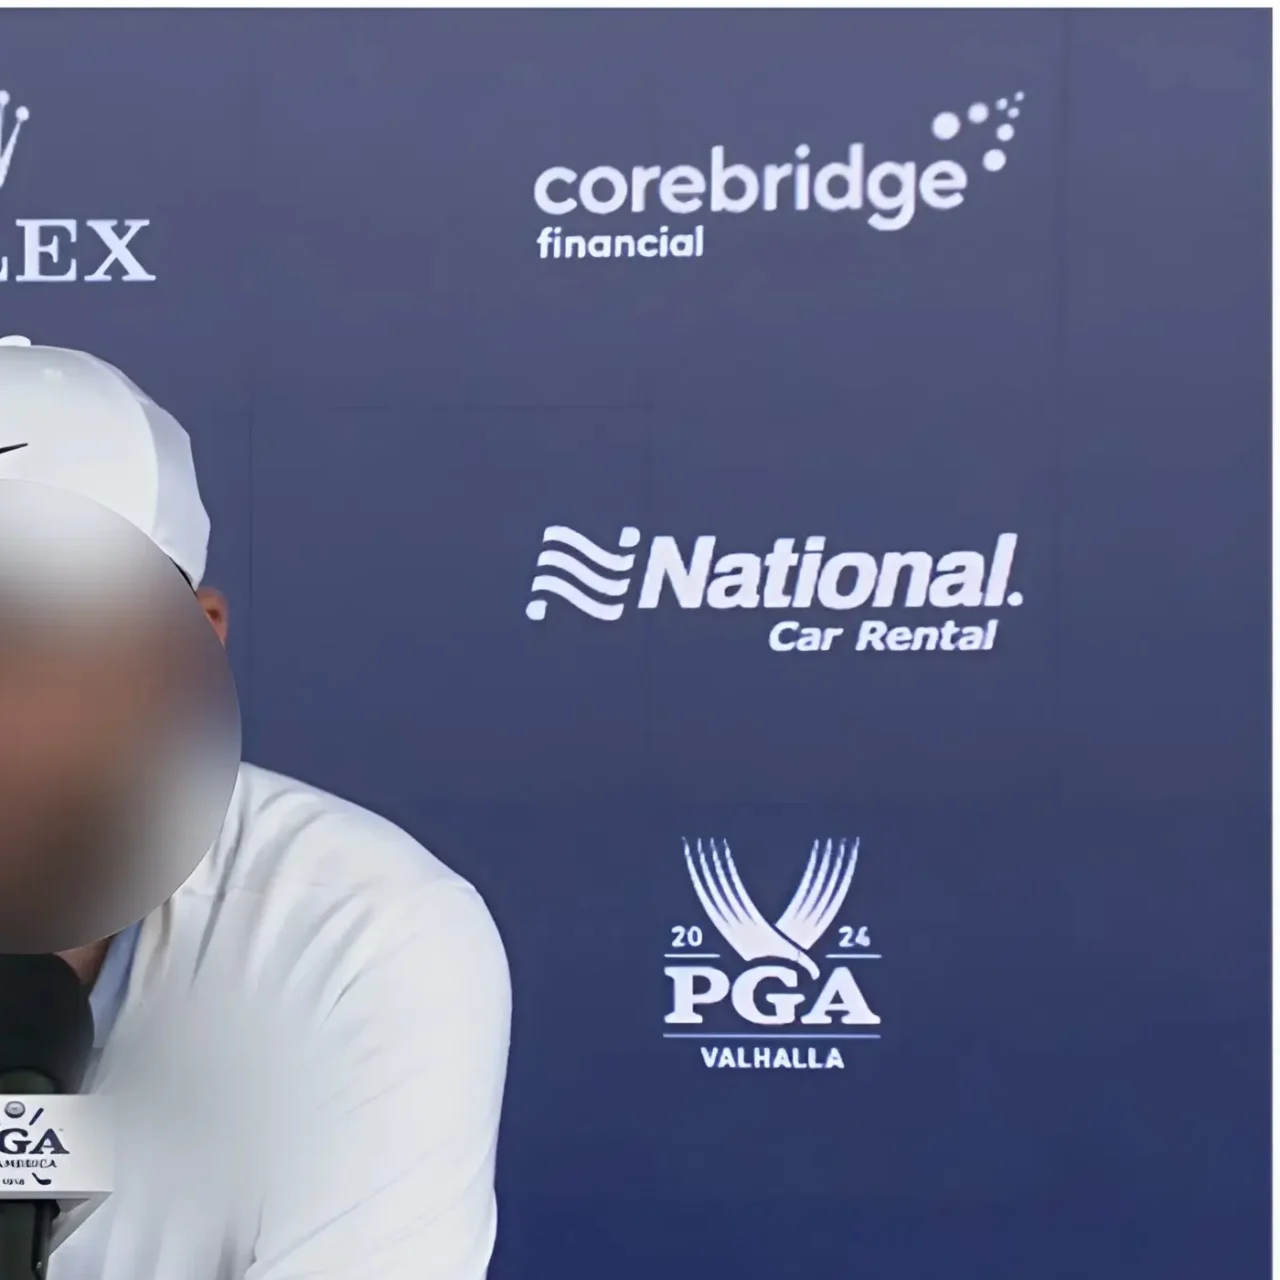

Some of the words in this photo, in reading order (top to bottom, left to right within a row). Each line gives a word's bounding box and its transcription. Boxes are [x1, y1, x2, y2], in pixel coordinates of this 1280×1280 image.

[534, 142, 968, 231] corebridge
[536, 224, 704, 259] financial
[769, 620, 844, 652] Car
[855, 619, 999, 651] Rental
[671, 925, 703, 948] 20
[664, 965, 881, 1025] PGA
[700, 1046, 845, 1069] VALHALLA
